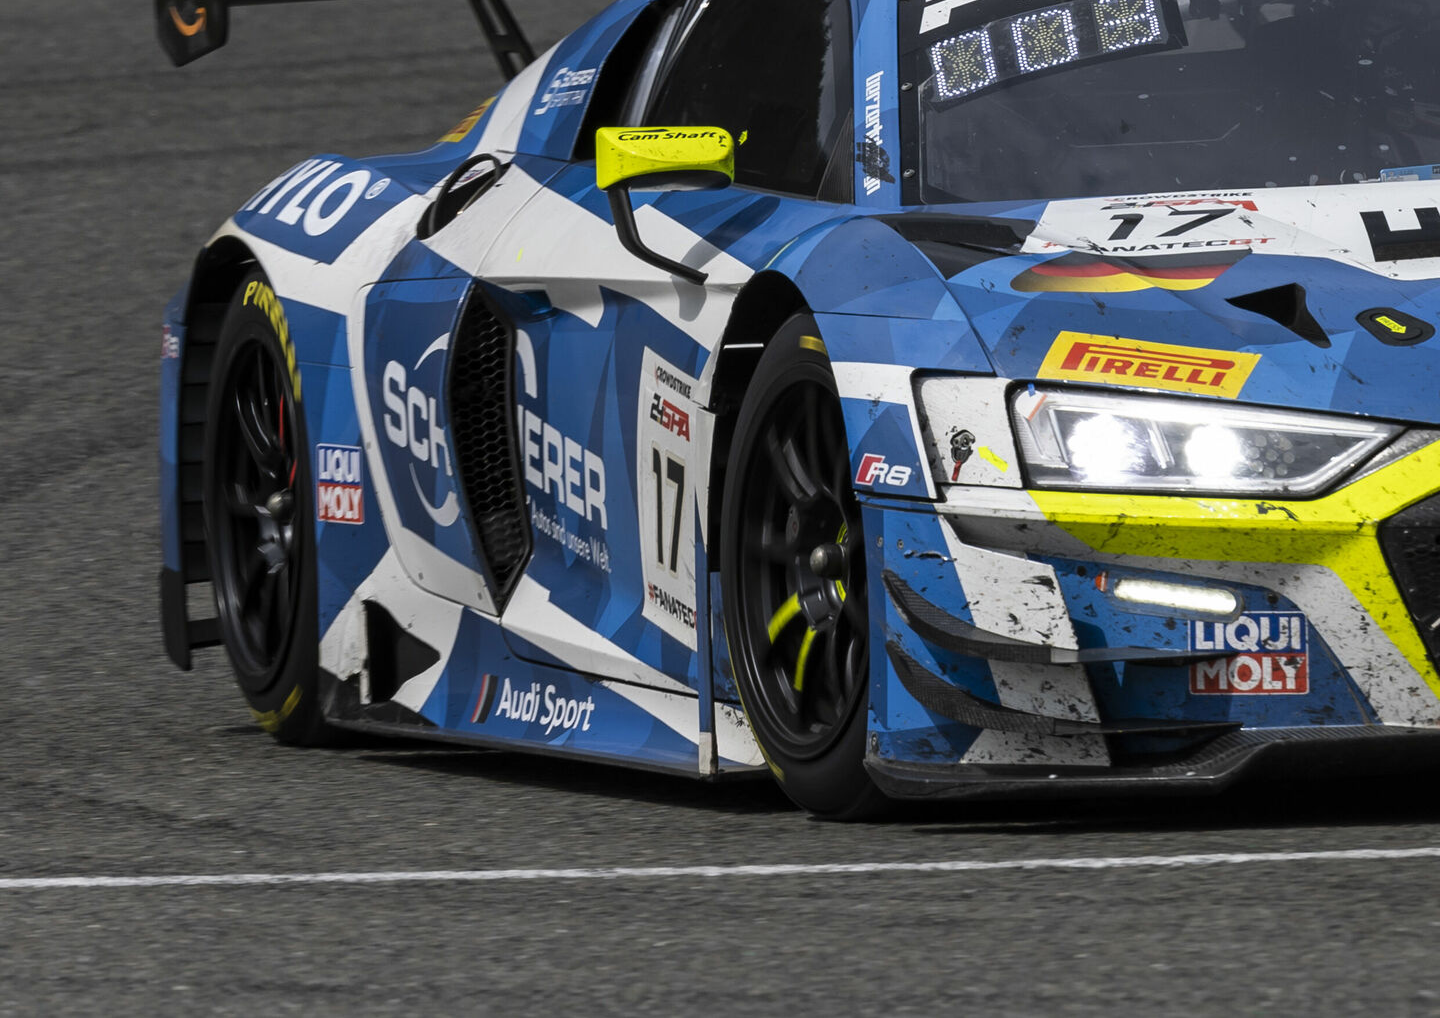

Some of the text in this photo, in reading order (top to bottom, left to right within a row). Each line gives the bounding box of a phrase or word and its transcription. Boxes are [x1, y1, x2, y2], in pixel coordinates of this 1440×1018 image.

[617, 131, 717, 141] Cam Shaft
[1107, 207, 1238, 241] 17
[1060, 341, 1236, 388] PIRELLI
[318, 448, 361, 483] LIQUI
[865, 462, 912, 486] R8
[318, 485, 362, 520] MOLY
[652, 443, 686, 576] 17
[1195, 615, 1302, 653] LIQUI
[1195, 655, 1306, 691] MOLY
[496, 677, 595, 735] Audi Sport
